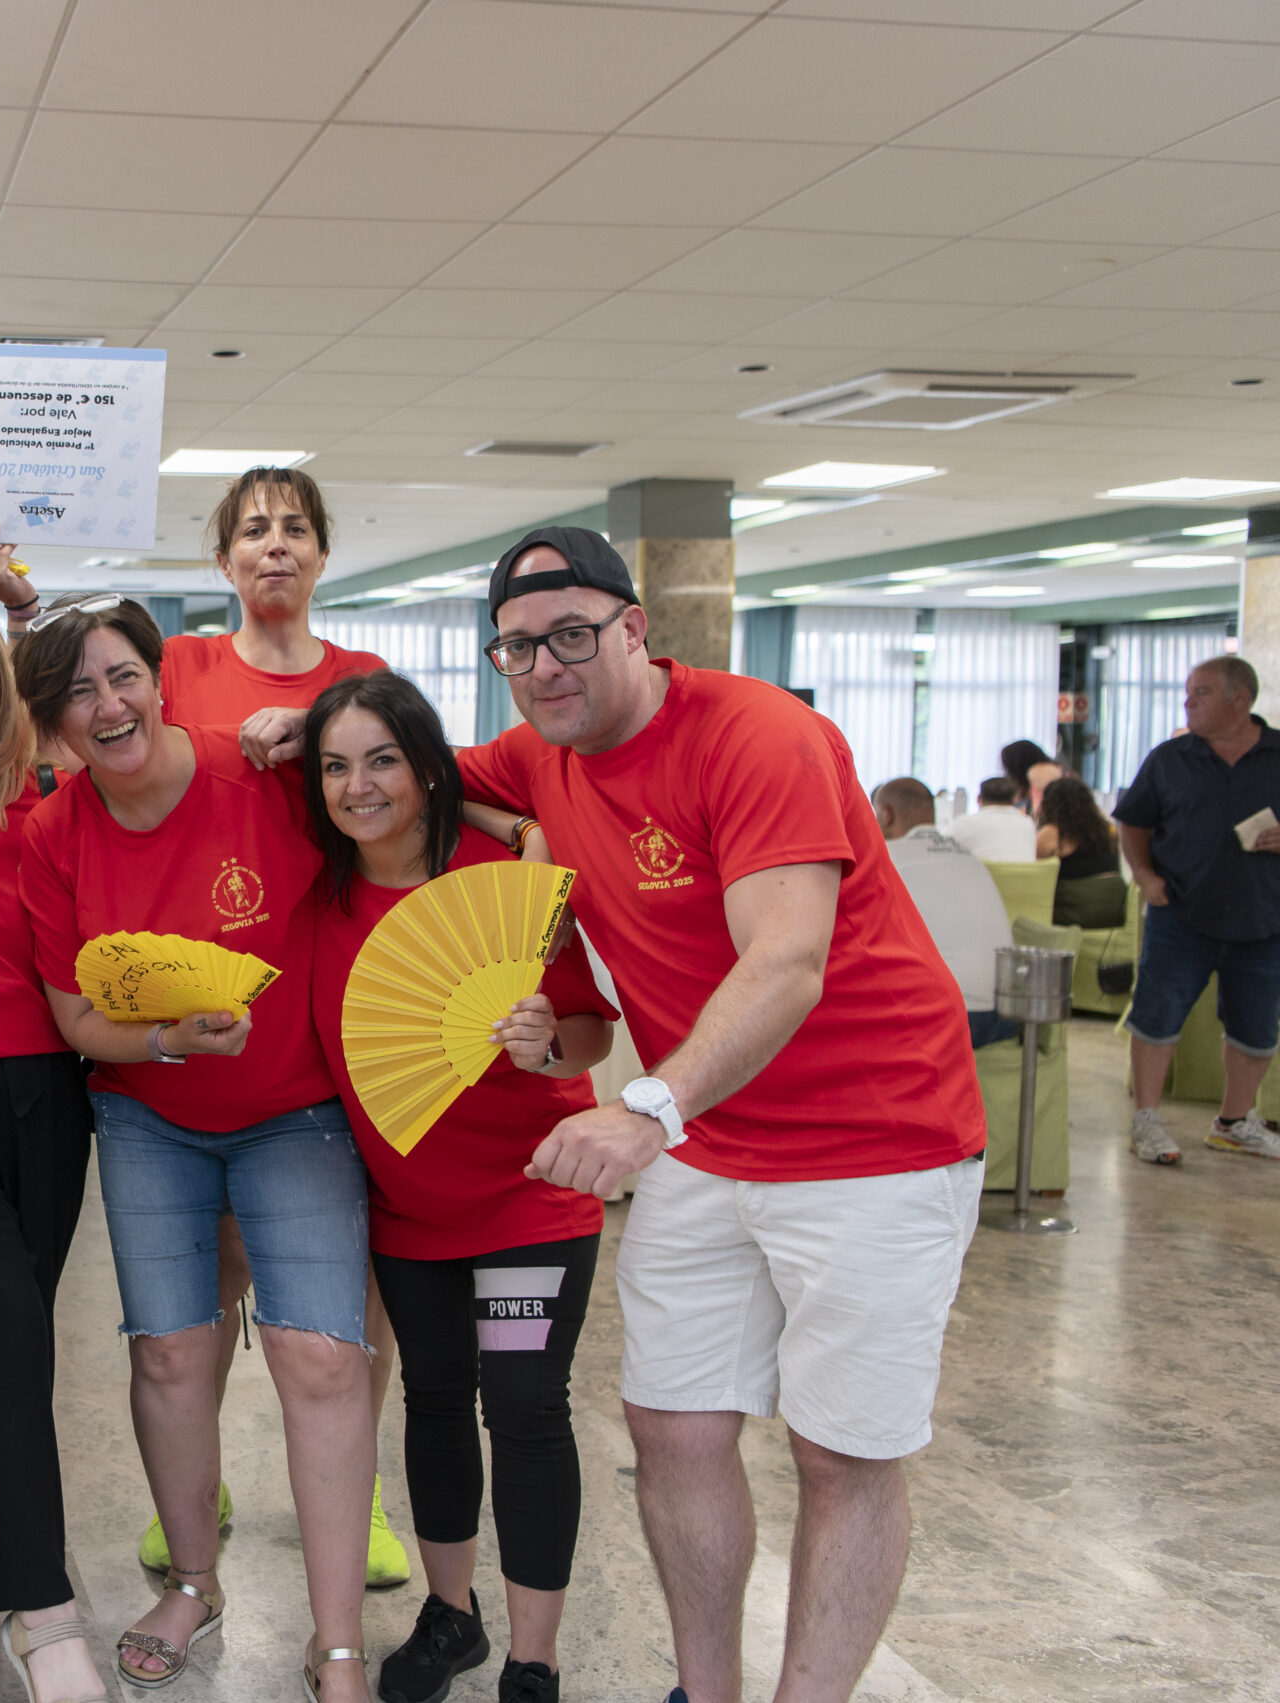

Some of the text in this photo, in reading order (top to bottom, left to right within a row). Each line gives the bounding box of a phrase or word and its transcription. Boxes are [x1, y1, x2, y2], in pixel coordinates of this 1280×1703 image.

[56, 394, 72, 404] de
[94, 395, 114, 405] 150
[21, 407, 76, 420] Vale por:
[1, 426, 91, 438] Mejor Engalanado
[0, 440, 43, 448] Vehículo
[46, 441, 82, 449] Premio
[18, 464, 76, 479] Cristóbal
[80, 466, 105, 481] San
[19, 506, 66, 519] Asetra
[557, 872, 574, 898] 2025
[638, 876, 694, 890] SEGOVIA 2025
[221, 918, 254, 933] SEGOVIA
[489, 1300, 544, 1317] POWER
